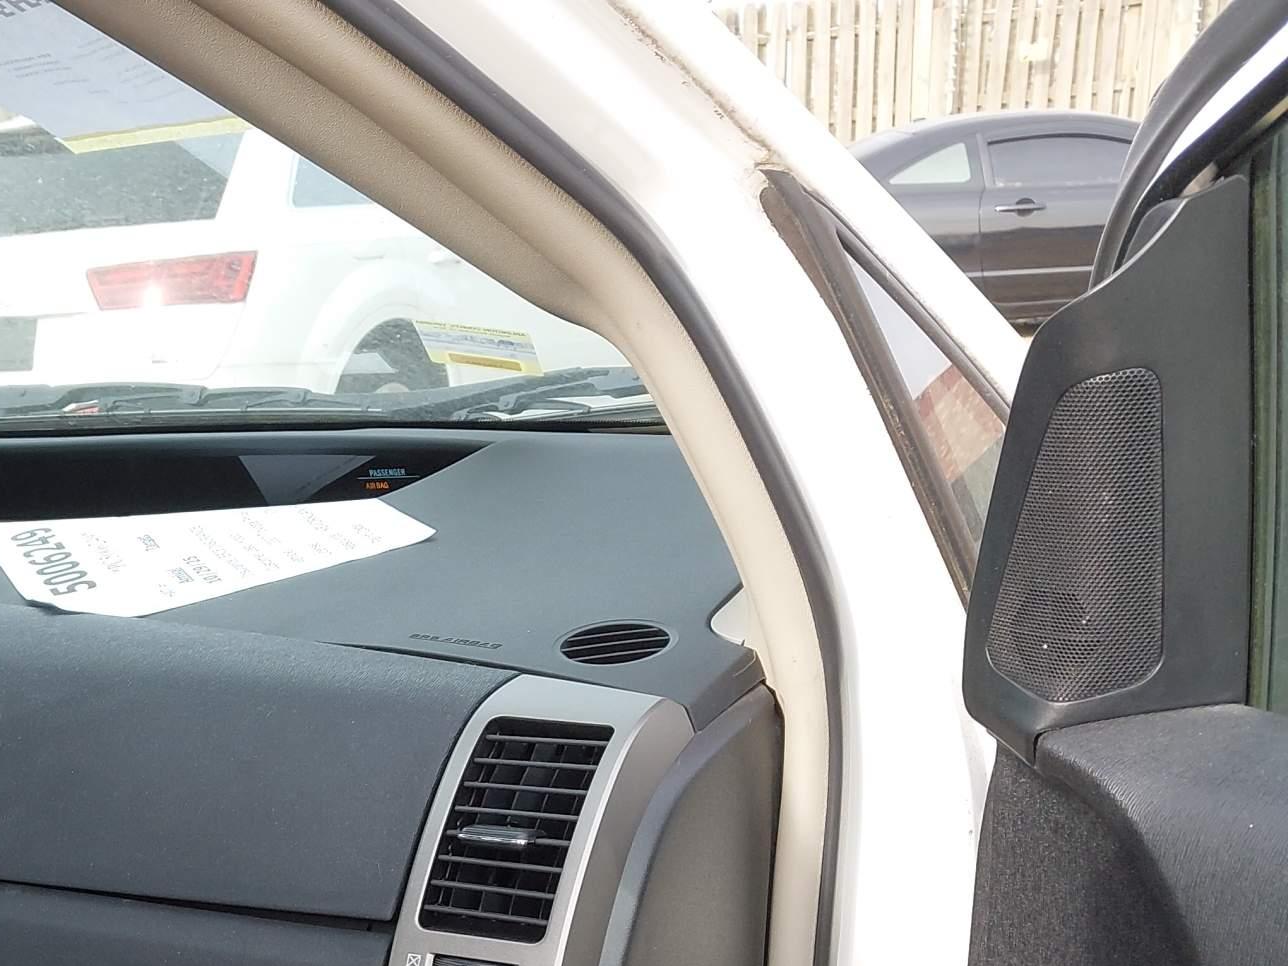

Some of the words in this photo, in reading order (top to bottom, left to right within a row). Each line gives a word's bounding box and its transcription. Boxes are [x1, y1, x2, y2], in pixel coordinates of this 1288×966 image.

[368, 468, 406, 477] PASSENGER
[11, 528, 97, 596] 5006249
[182, 556, 222, 584] 10/29/25
